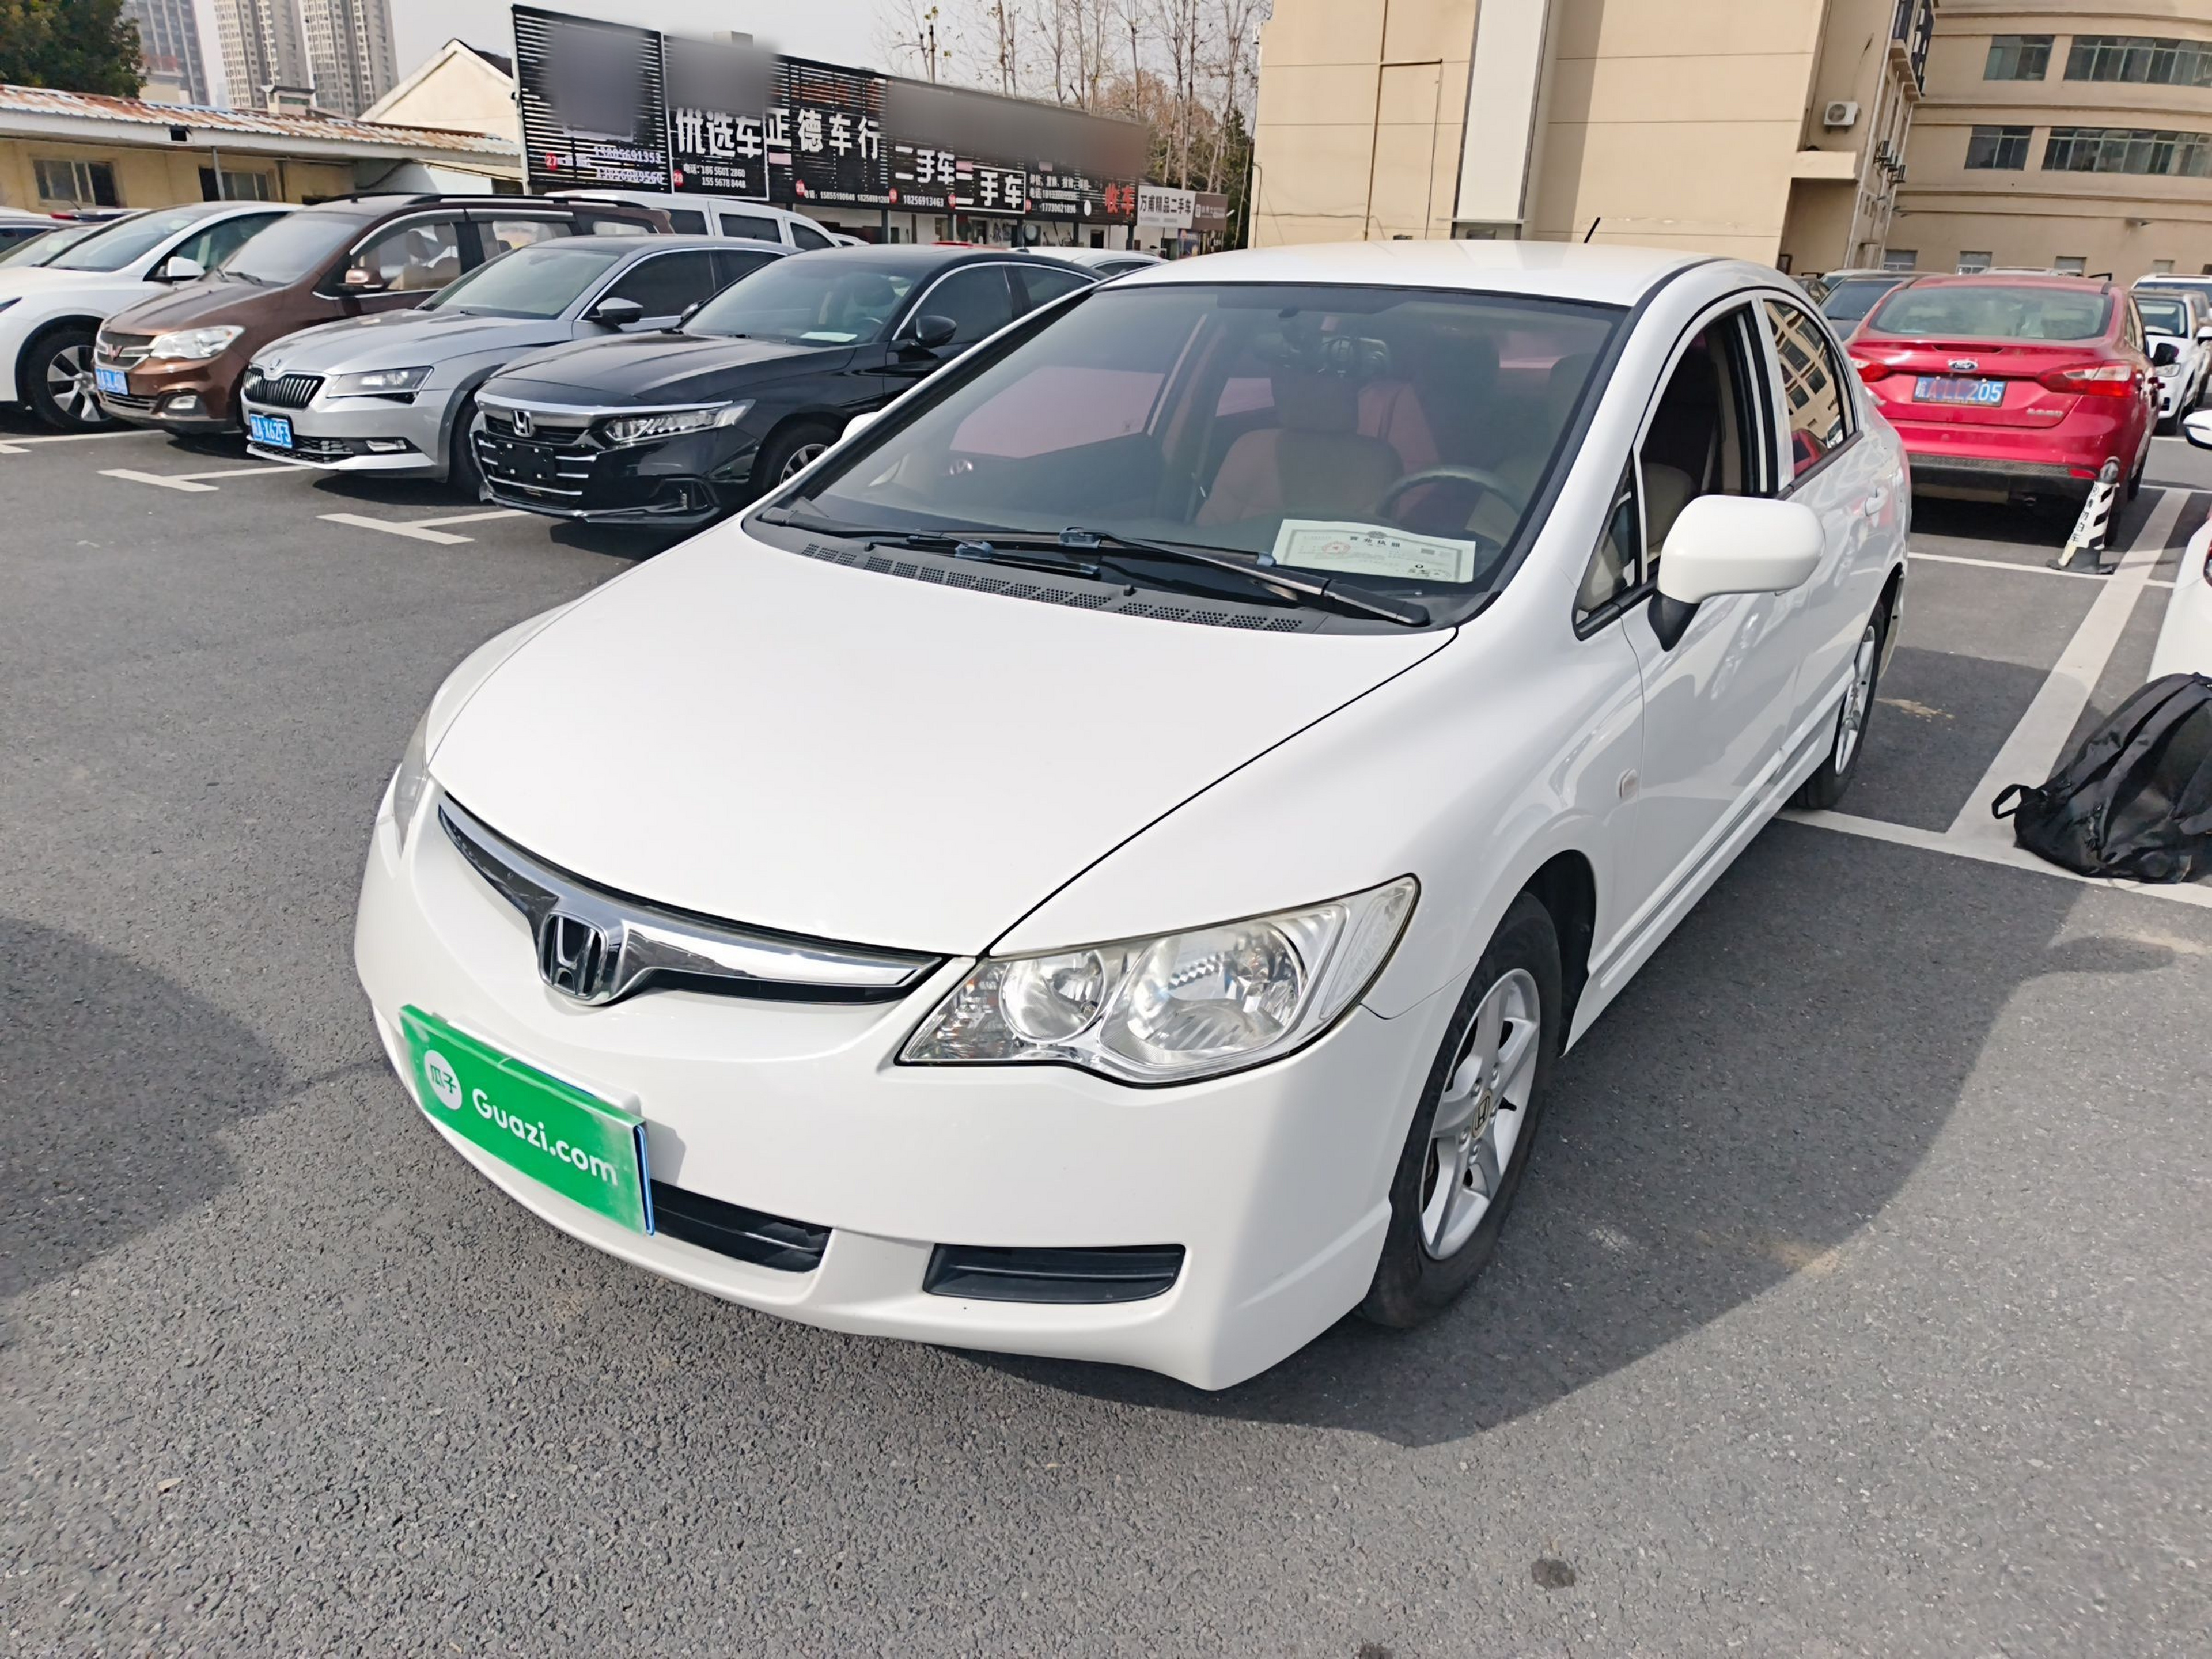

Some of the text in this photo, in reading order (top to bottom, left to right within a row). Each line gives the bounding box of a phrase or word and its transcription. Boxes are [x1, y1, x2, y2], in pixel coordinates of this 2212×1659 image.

[676, 108, 763, 158] 优选车
[766, 108, 881, 160] 正德车行
[546, 155, 557, 166] 27
[702, 165, 713, 175] 186
[730, 168, 745, 177] 2860
[895, 145, 955, 185] 二手车
[674, 173, 683, 183] 28
[702, 177, 746, 189] 155 5678 8448
[956, 171, 1022, 209] 二手车
[903, 195, 945, 208] 18256913463
[1105, 182, 1135, 215] 收车
[1139, 194, 1191, 215] 万甫精品二手车
[431, 1065, 457, 1094] 瓜子
[472, 1088, 619, 1187] Guazi.com
